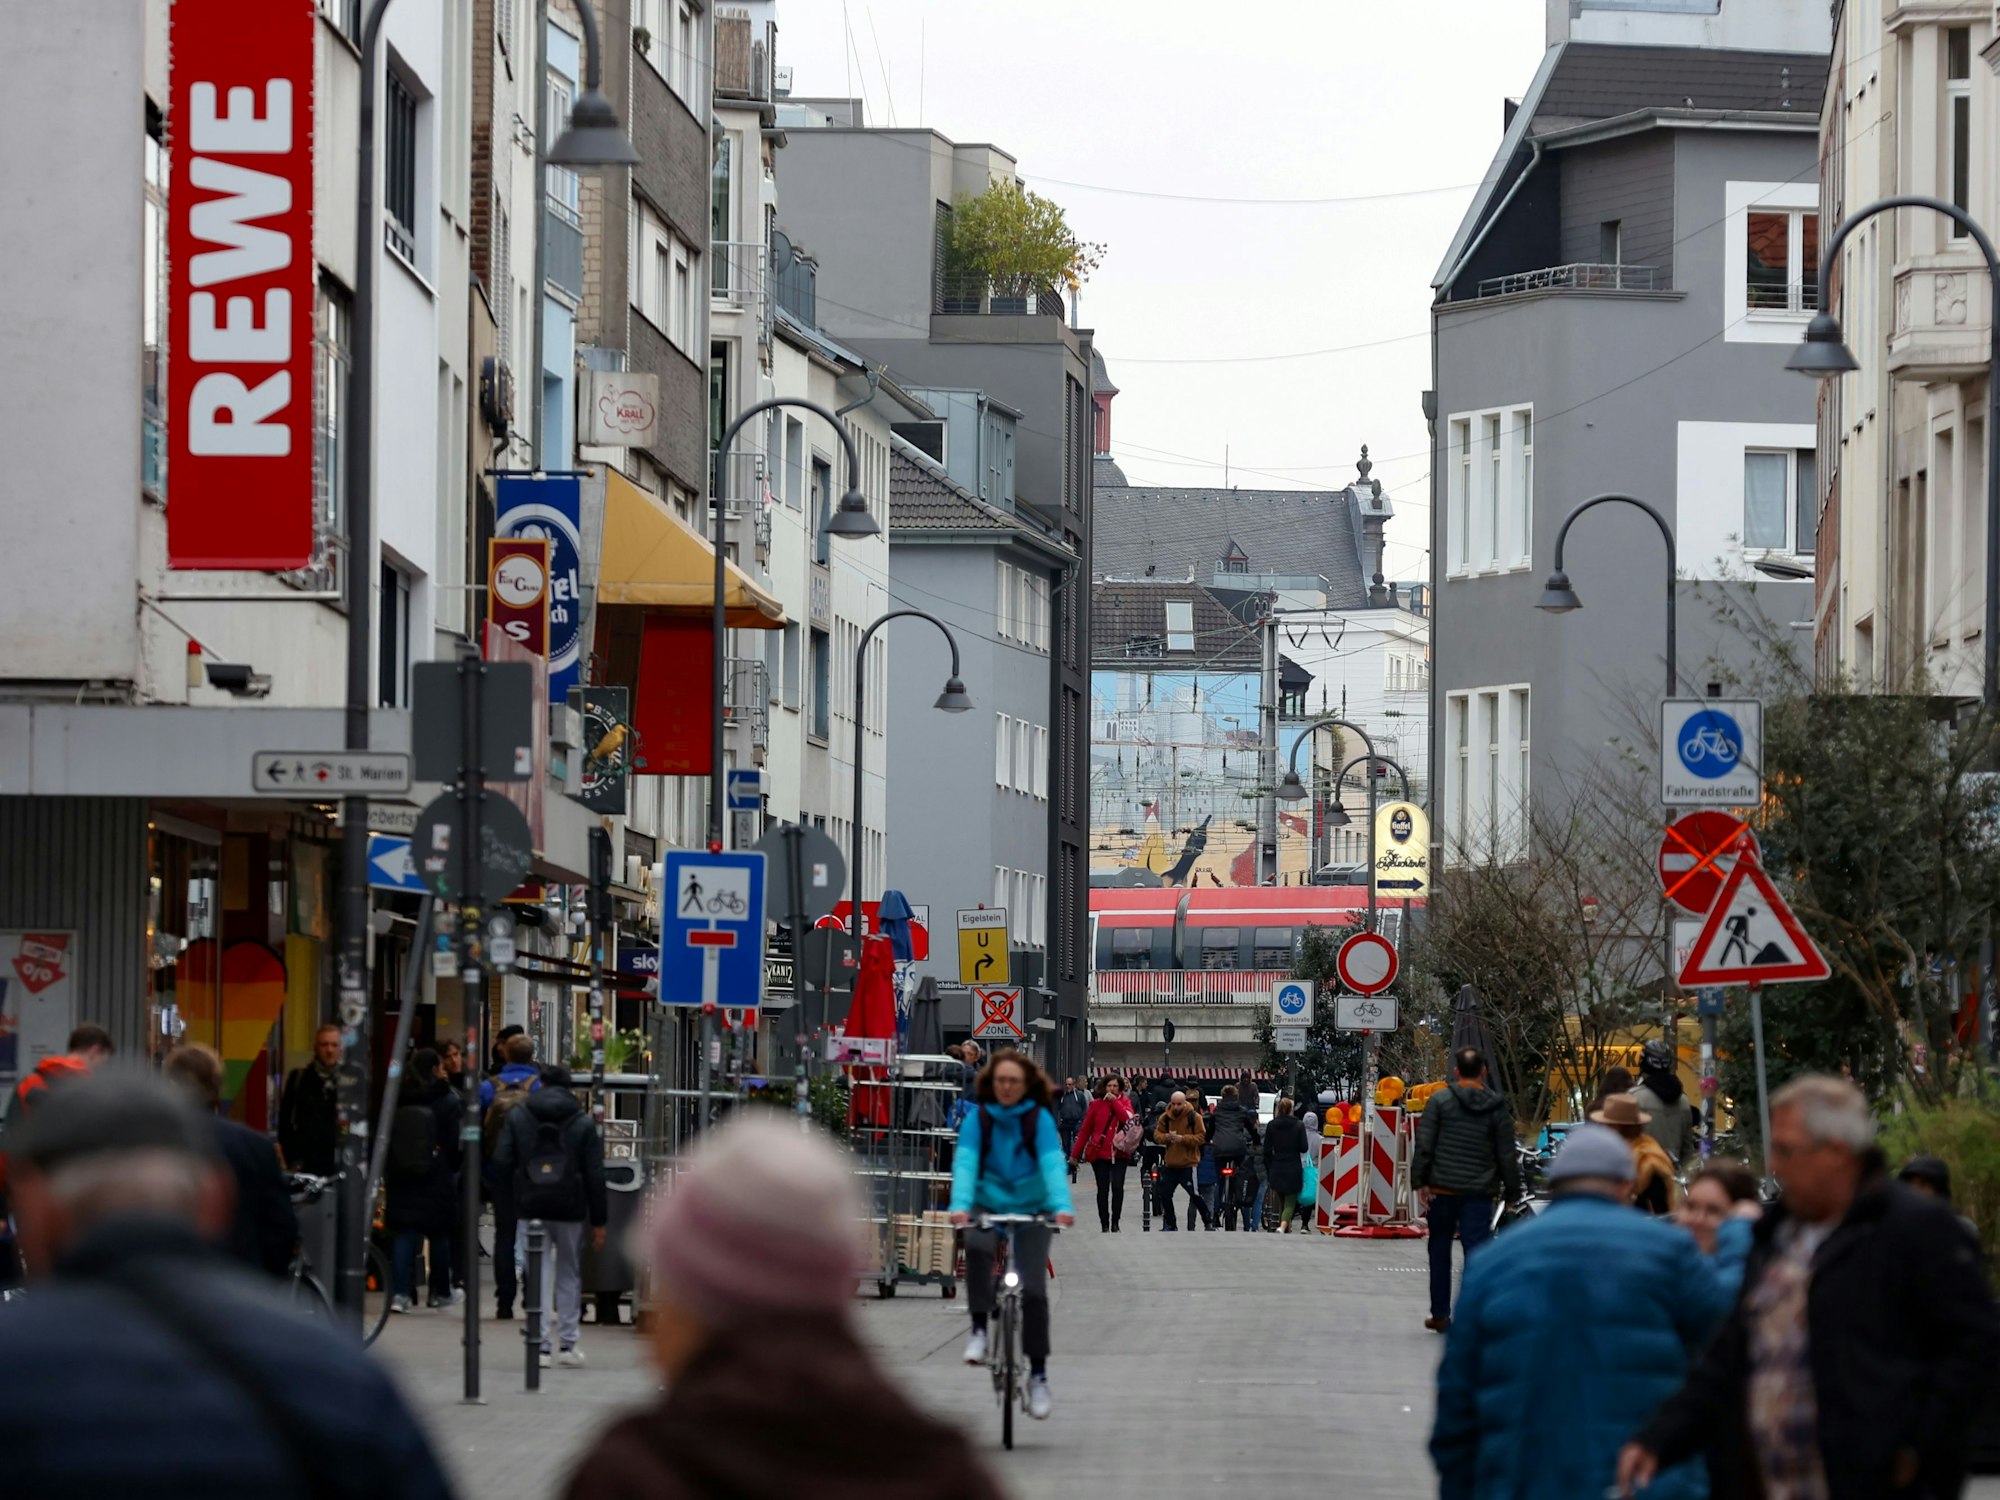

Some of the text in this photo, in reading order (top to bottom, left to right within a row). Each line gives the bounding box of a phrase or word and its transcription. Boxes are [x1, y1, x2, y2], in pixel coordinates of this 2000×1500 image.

[188, 77, 293, 457] REWE
[616, 407, 644, 420] KRALL
[338, 765, 403, 781] St. Marien
[1666, 784, 1755, 797] Fahrradstraße
[962, 913, 1001, 924] Eigelstein
[977, 932, 989, 947] U
[1296, 936, 1302, 946] 2
[632, 953, 659, 973] sky
[1360, 1018, 1375, 1026] frei
[985, 1026, 1010, 1034] ZONE
